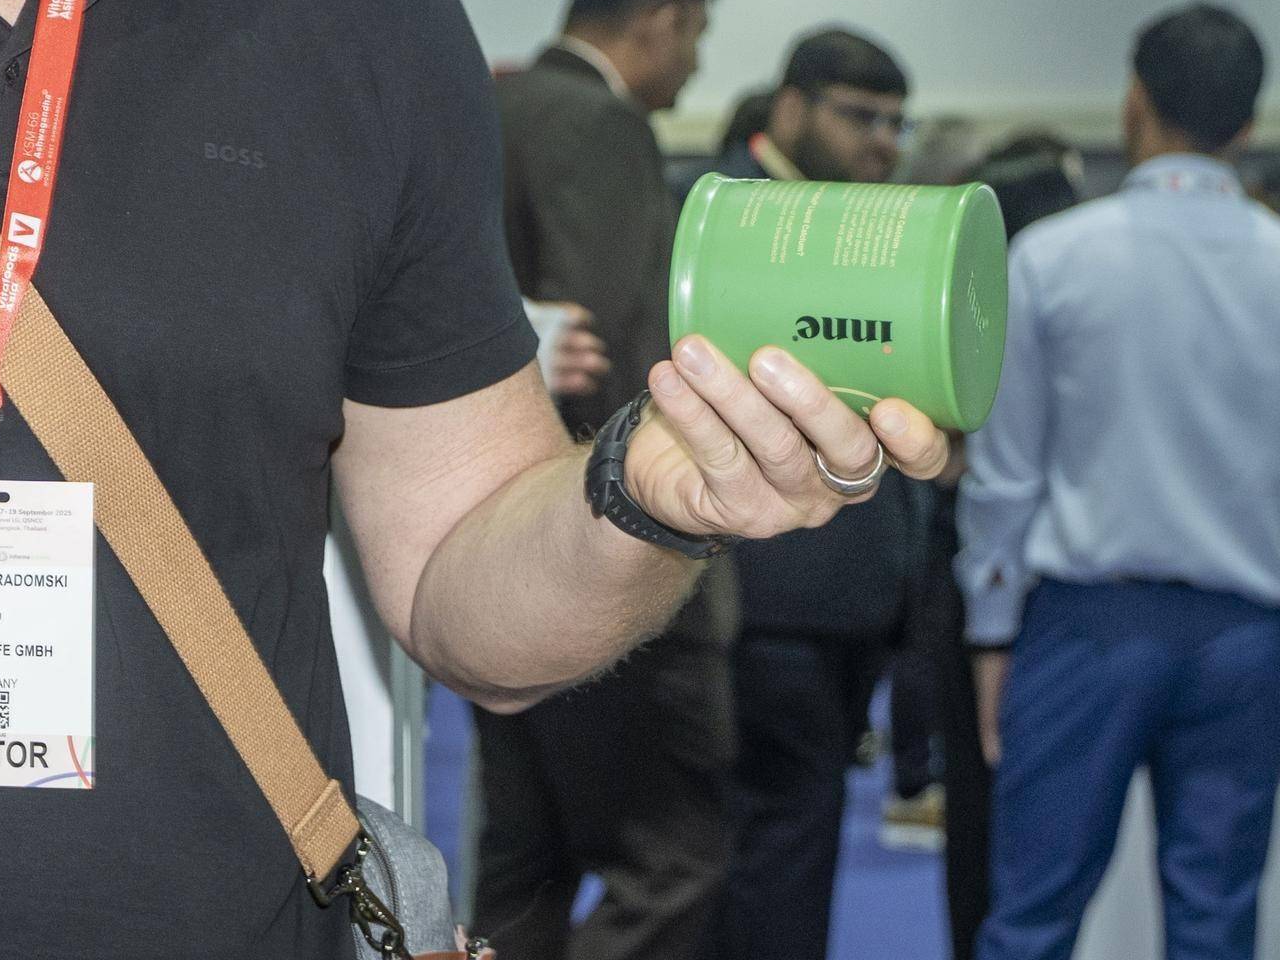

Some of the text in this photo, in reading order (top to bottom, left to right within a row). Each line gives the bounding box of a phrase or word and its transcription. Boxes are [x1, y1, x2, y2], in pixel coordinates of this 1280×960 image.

[22, 111, 40, 157] KSM-66
[204, 142, 265, 169] BOSS
[18, 509, 53, 518] September
[14, 644, 54, 657] GMBH
